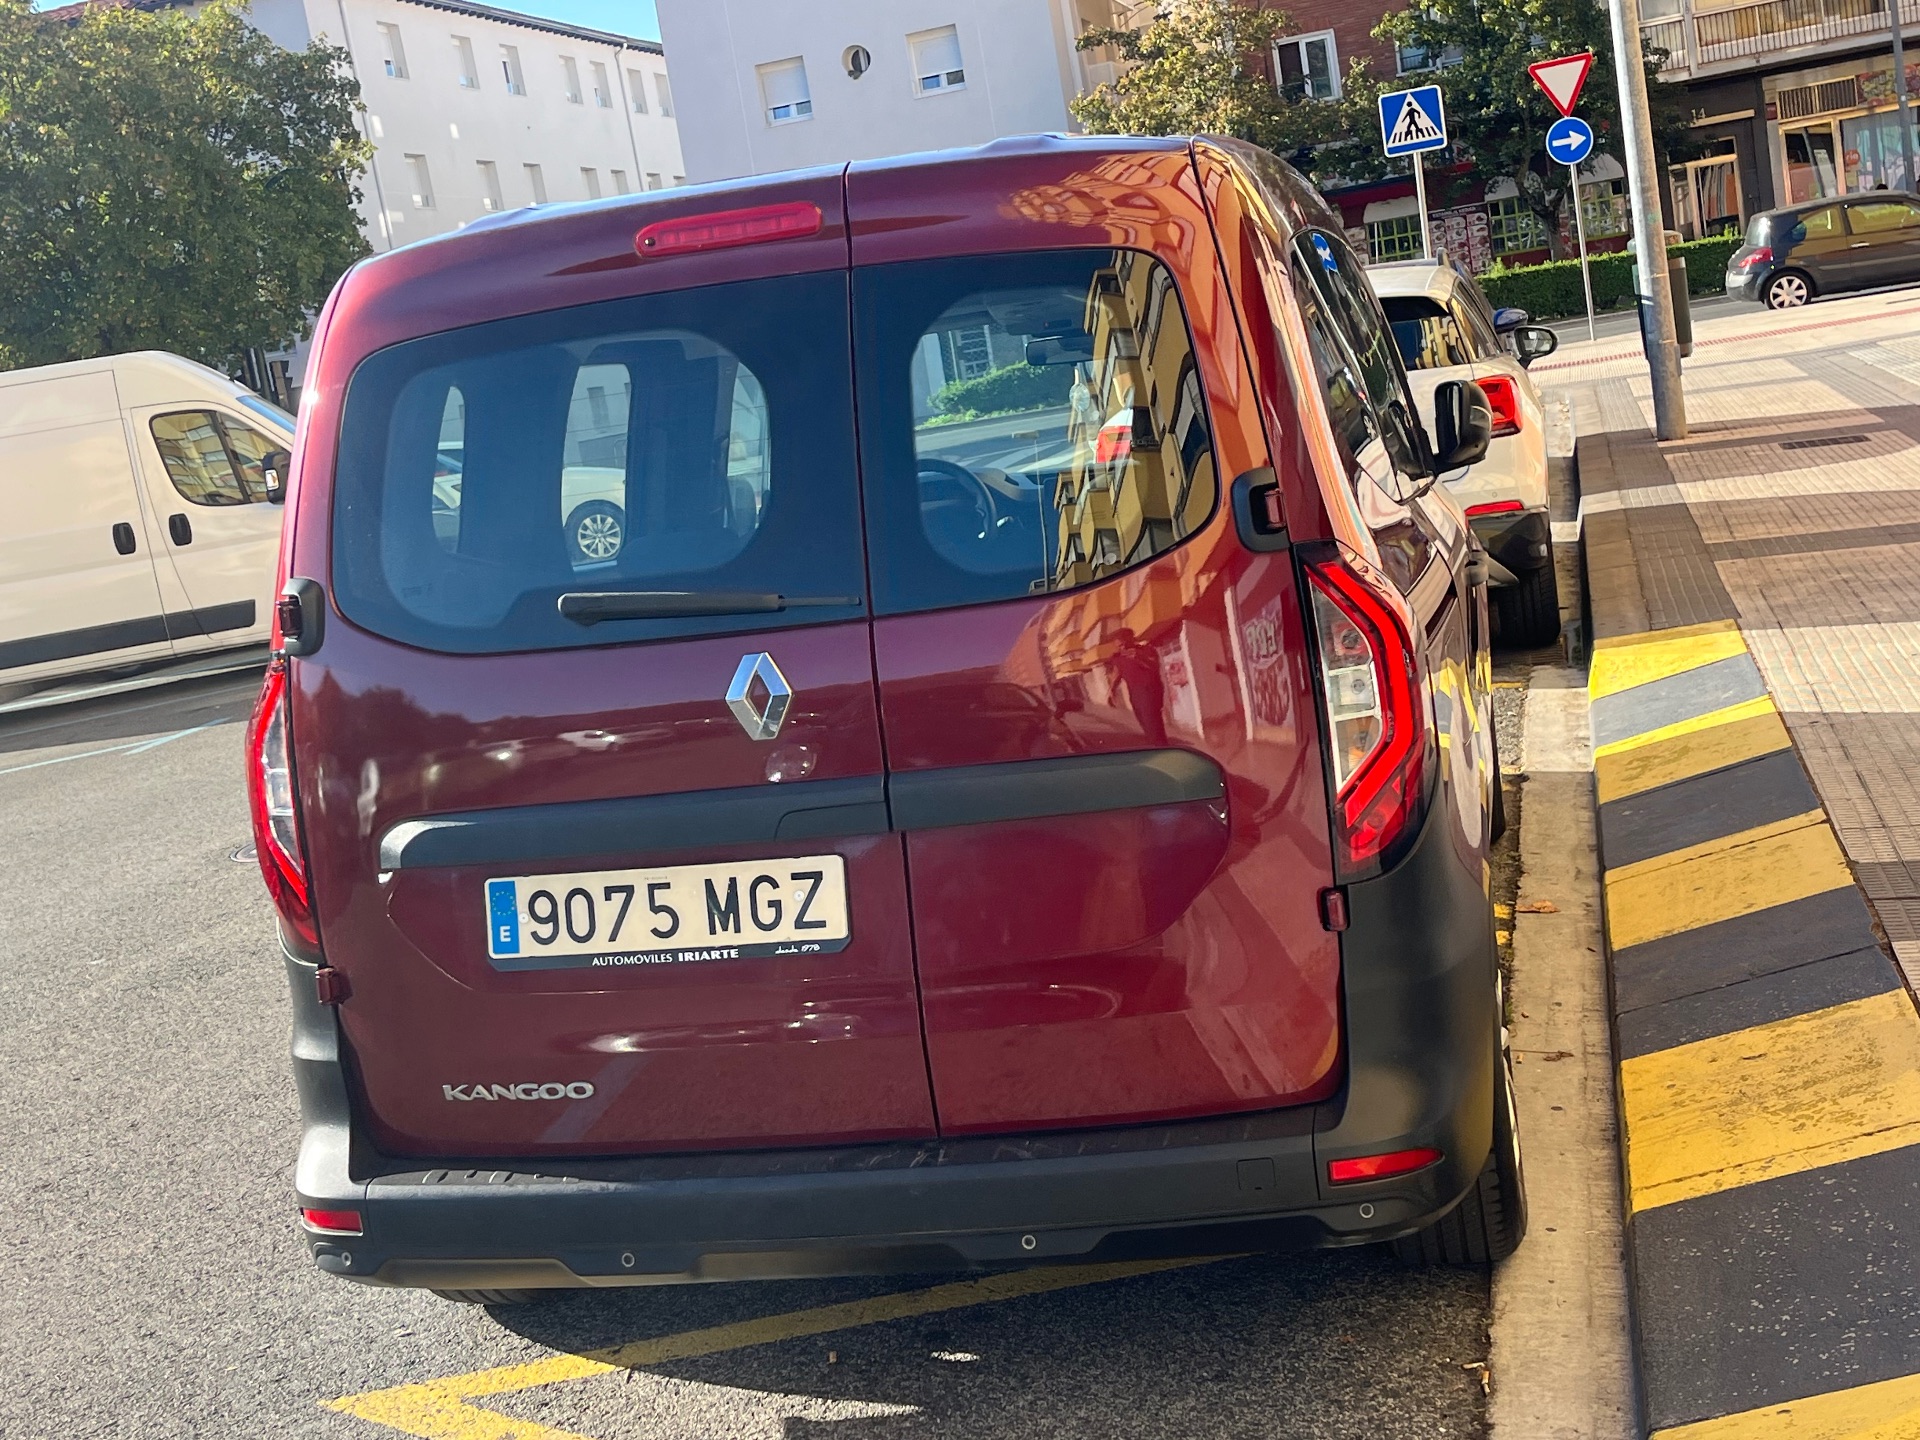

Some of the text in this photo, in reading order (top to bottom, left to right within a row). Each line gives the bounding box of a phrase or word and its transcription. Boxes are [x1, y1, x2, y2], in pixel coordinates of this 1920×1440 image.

[1691, 108, 1707, 121] 14
[527, 870, 827, 946] 9075 MGZ
[499, 925, 511, 942] E
[677, 949, 739, 962] IRIARTE
[442, 1081, 595, 1101] KANGOO
